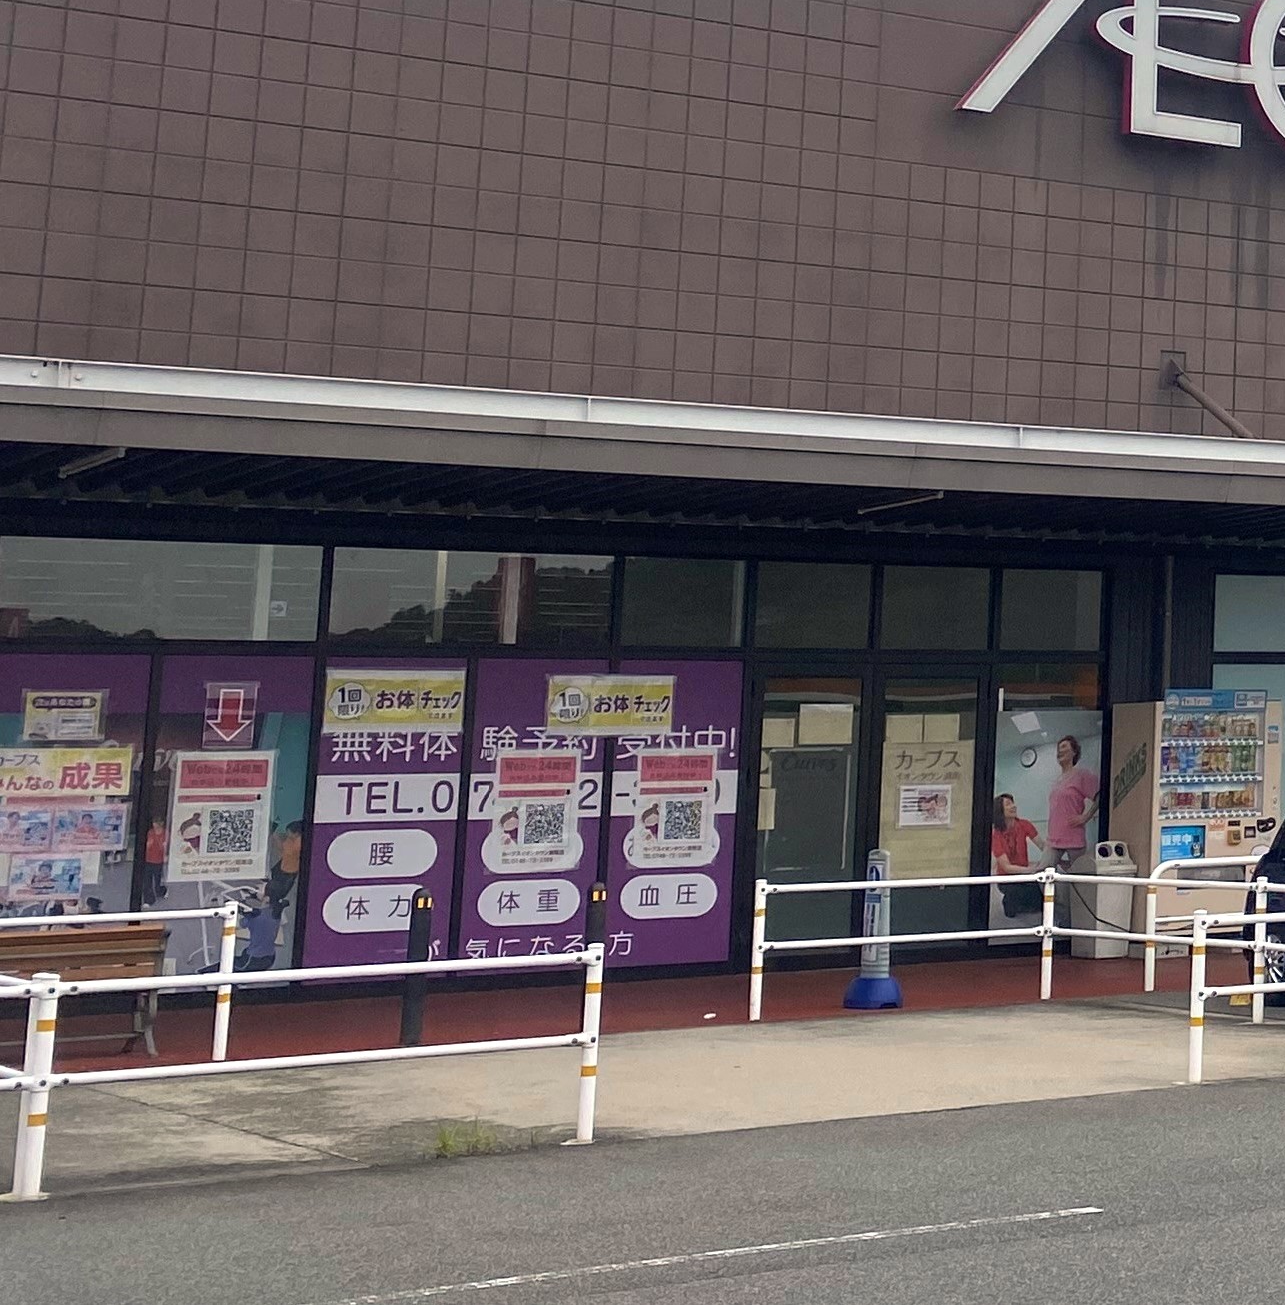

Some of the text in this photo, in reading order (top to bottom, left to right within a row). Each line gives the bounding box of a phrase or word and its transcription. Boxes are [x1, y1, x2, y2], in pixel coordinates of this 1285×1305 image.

[894, 749, 962, 770] カーブス
[367, 842, 395, 868] 腰
[497, 888, 561, 915] 体重
[638, 882, 699, 908] 血圧
